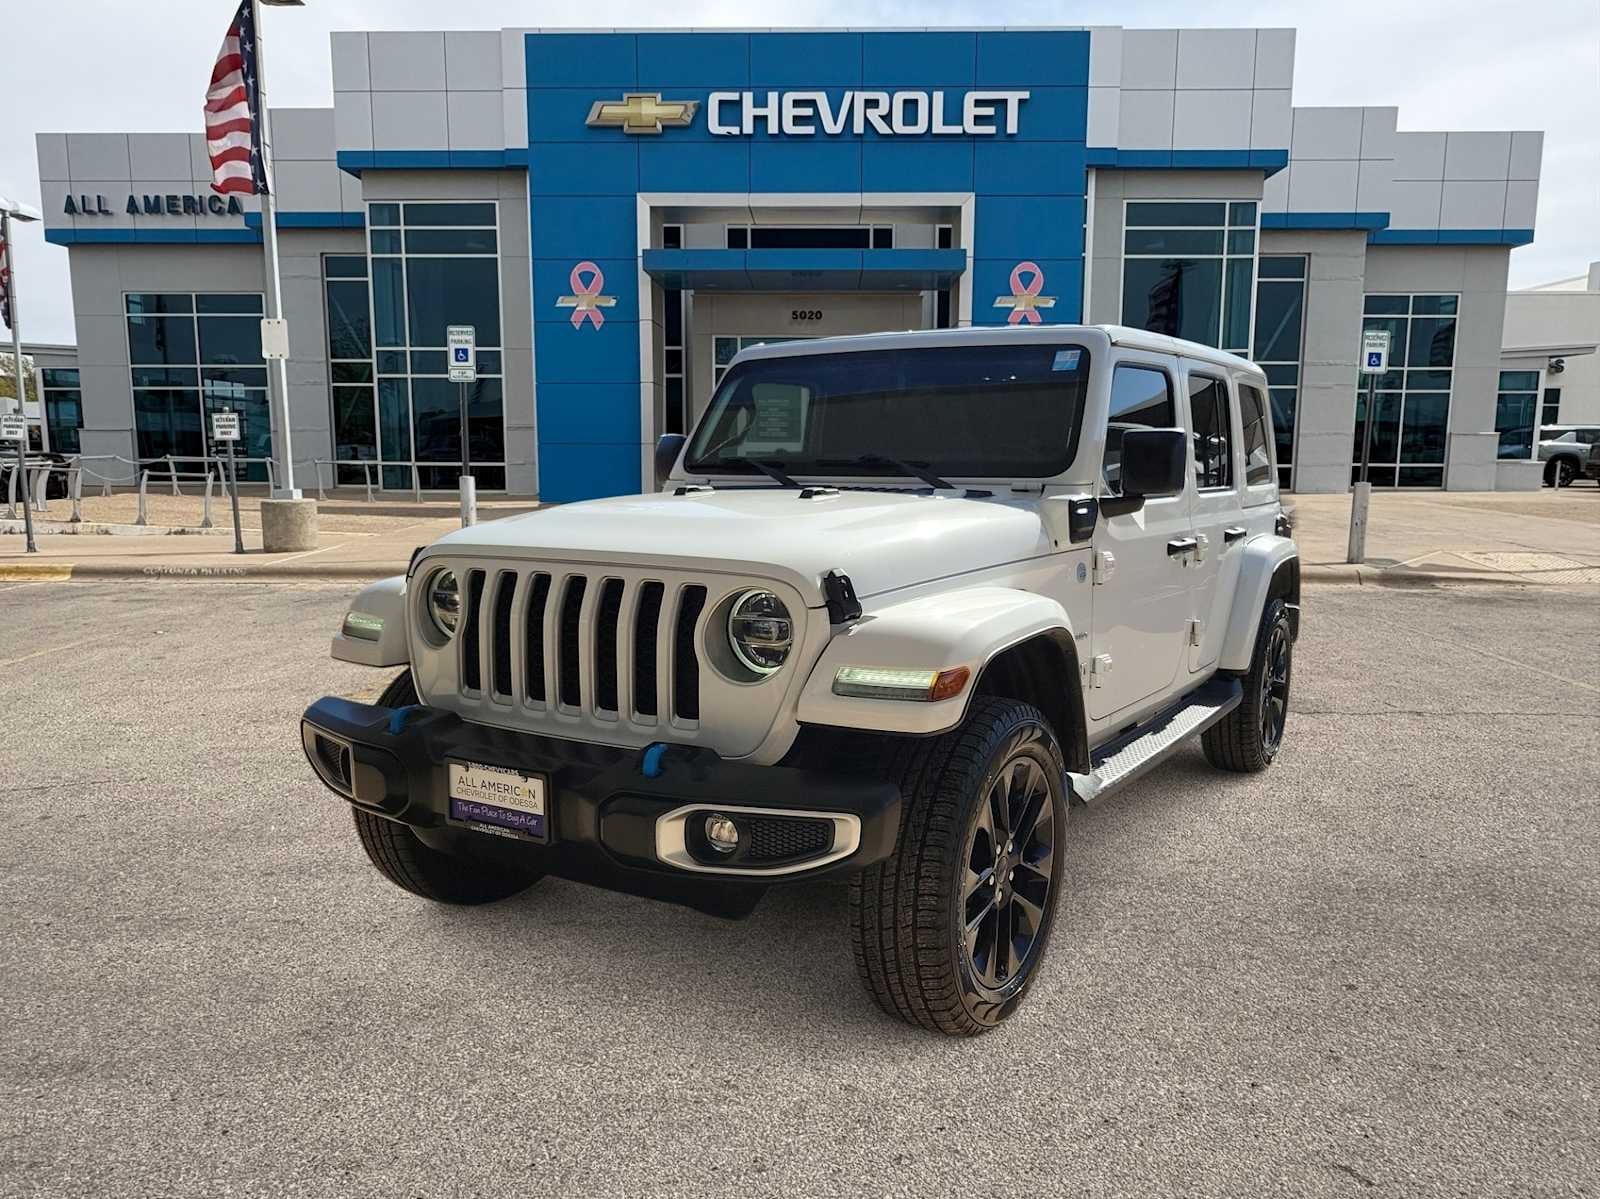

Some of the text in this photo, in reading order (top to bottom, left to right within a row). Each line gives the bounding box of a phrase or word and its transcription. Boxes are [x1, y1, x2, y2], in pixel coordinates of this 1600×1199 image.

[707, 90, 1031, 135] CHEVROLET
[63, 194, 113, 216] ALL
[791, 310, 823, 320] 5020
[458, 775, 477, 788] ALL
[456, 786, 538, 809] CHEVROLET OF ODESSA
[457, 801, 469, 812] The
[481, 805, 498, 817] Place
[519, 815, 526, 824] A
[526, 816, 538, 826] Car
